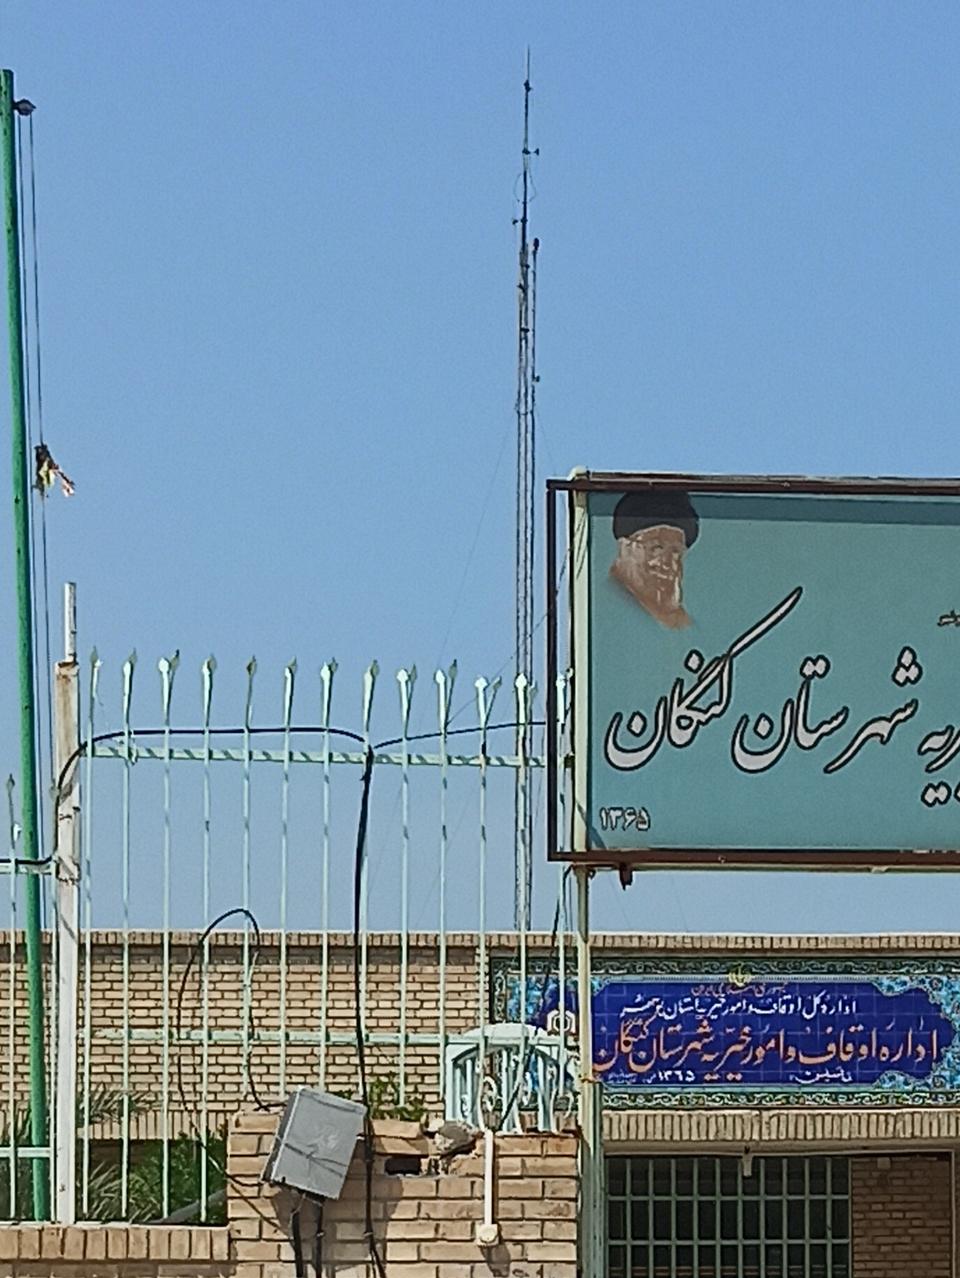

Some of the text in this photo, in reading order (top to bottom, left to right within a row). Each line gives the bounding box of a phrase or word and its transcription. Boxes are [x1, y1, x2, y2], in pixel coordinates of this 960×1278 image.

[604, 586, 803, 772] کنگان
[731, 646, 923, 775] شهرستان
[599, 806, 651, 832] ۱۳۶۵
[723, 998, 748, 1016] امور
[752, 994, 802, 1015] اوقاف
[801, 989, 827, 1020] کل
[821, 993, 857, 1016] اداره
[592, 1013, 938, 1082] اداره اوقاف و امور خیریه شهرستان کنگان
